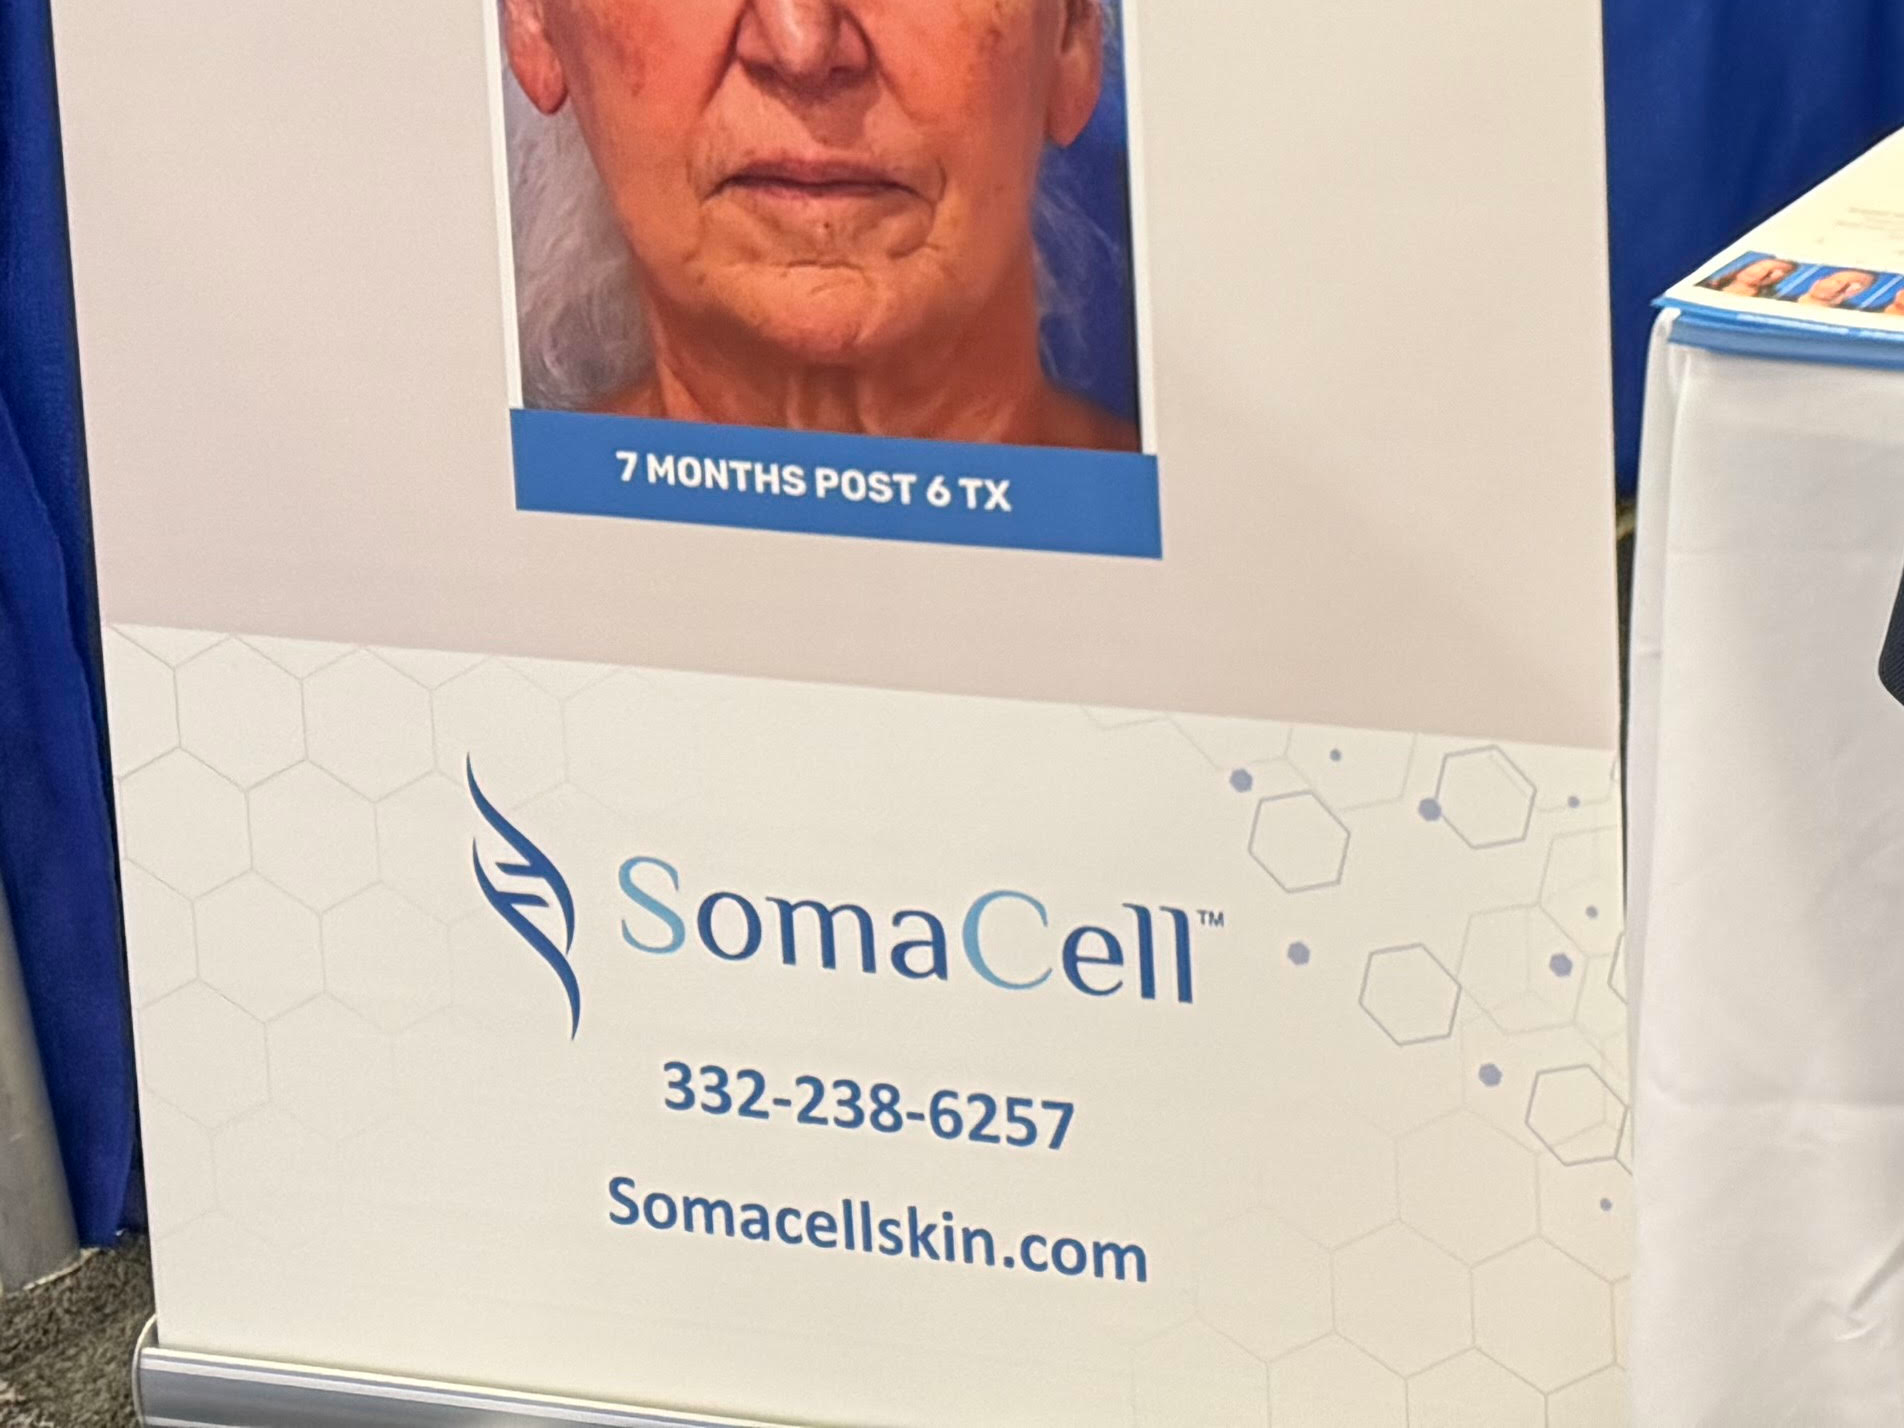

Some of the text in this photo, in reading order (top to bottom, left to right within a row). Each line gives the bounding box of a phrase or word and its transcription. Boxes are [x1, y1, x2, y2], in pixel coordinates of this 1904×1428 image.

[615, 451, 1013, 512] 7 MONTHS POST 6 TX
[661, 1059, 1076, 1152] 332-238-6257
[606, 1175, 1149, 1284] Somacellskin.com
